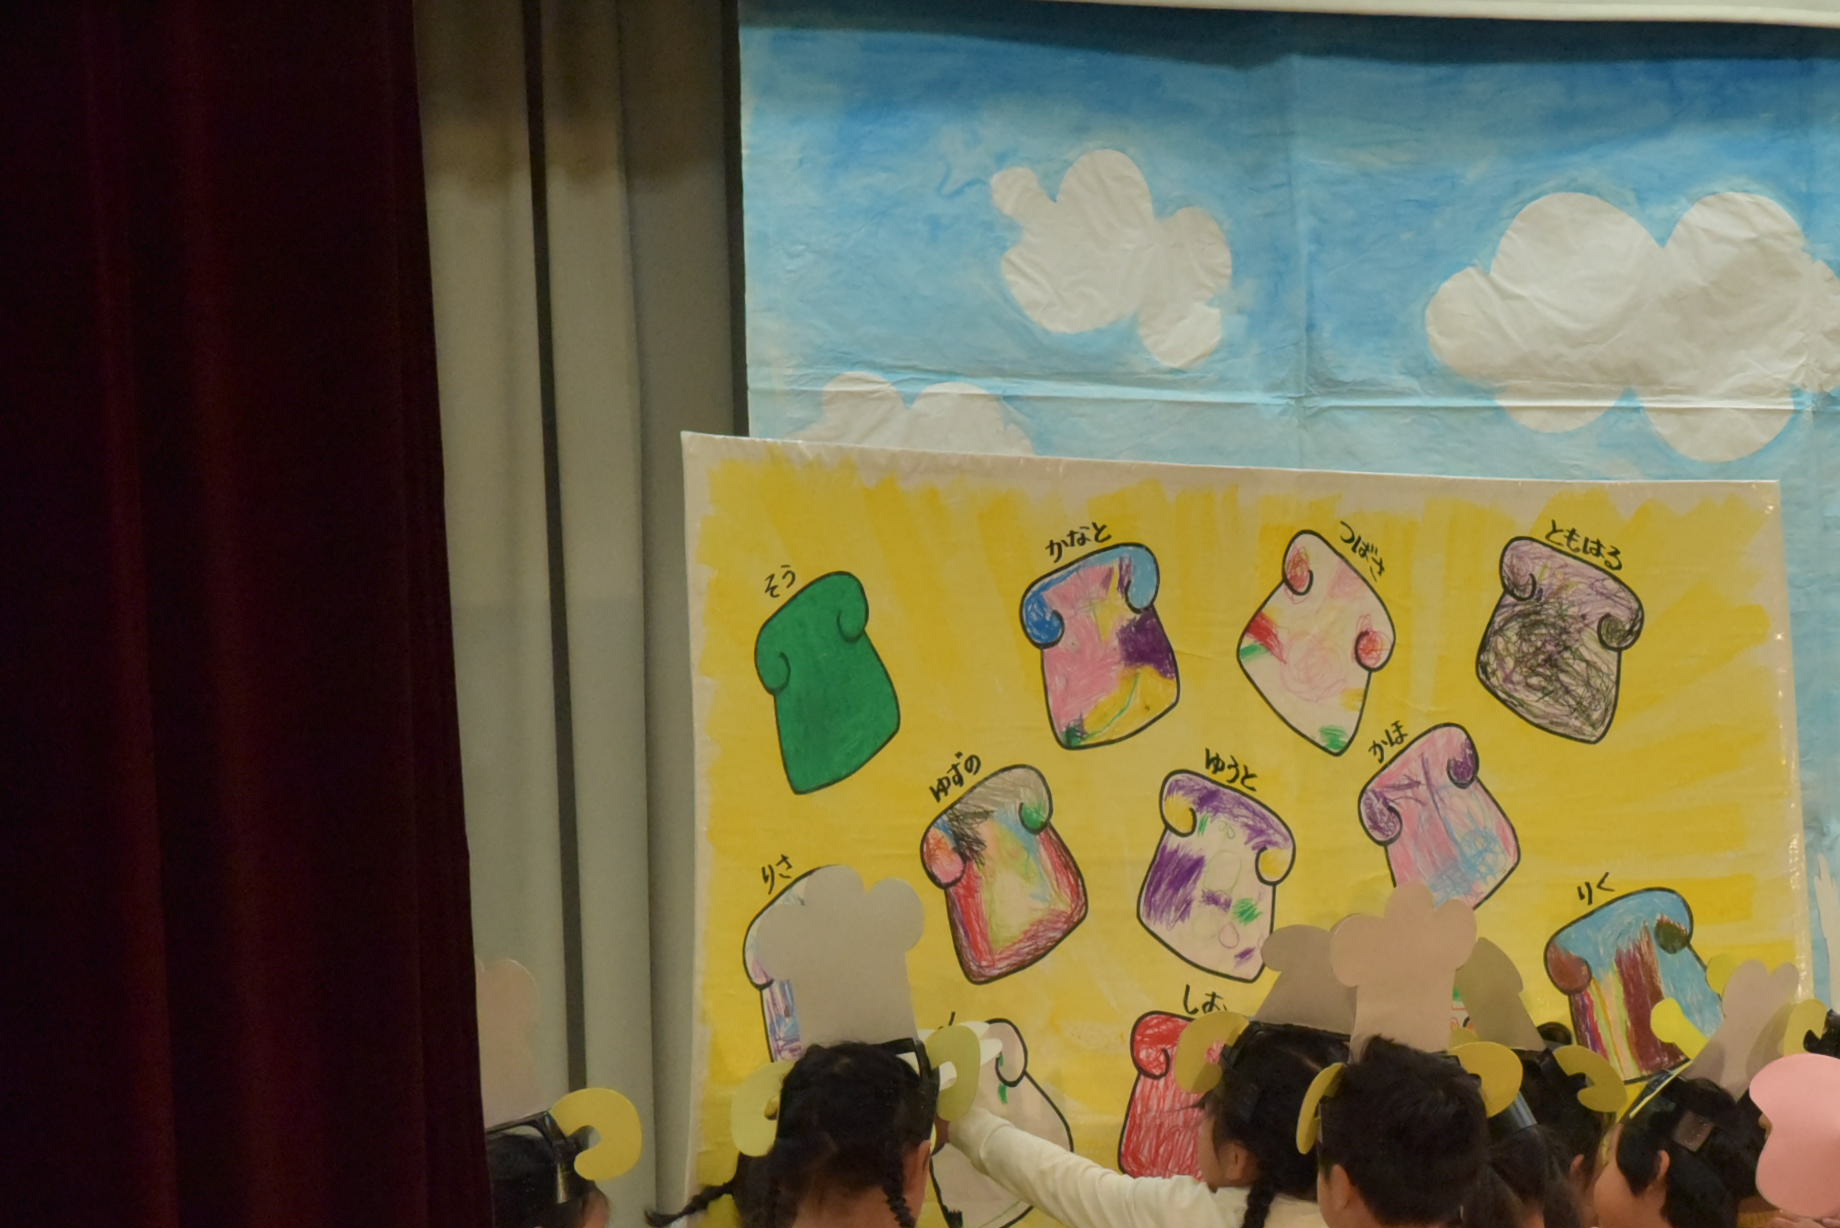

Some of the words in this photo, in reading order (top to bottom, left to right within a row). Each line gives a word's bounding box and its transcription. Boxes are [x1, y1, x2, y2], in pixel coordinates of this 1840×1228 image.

[1046, 522, 1113, 564] かなと
[1338, 521, 1386, 582] つばさ
[1545, 519, 1624, 572] ともはる
[764, 564, 797, 599] そう
[1368, 720, 1409, 764] かほ
[929, 751, 982, 804] ゆずの
[1204, 748, 1258, 792] ゆうと
[761, 854, 794, 897] りさ
[1577, 872, 1616, 906] りく
